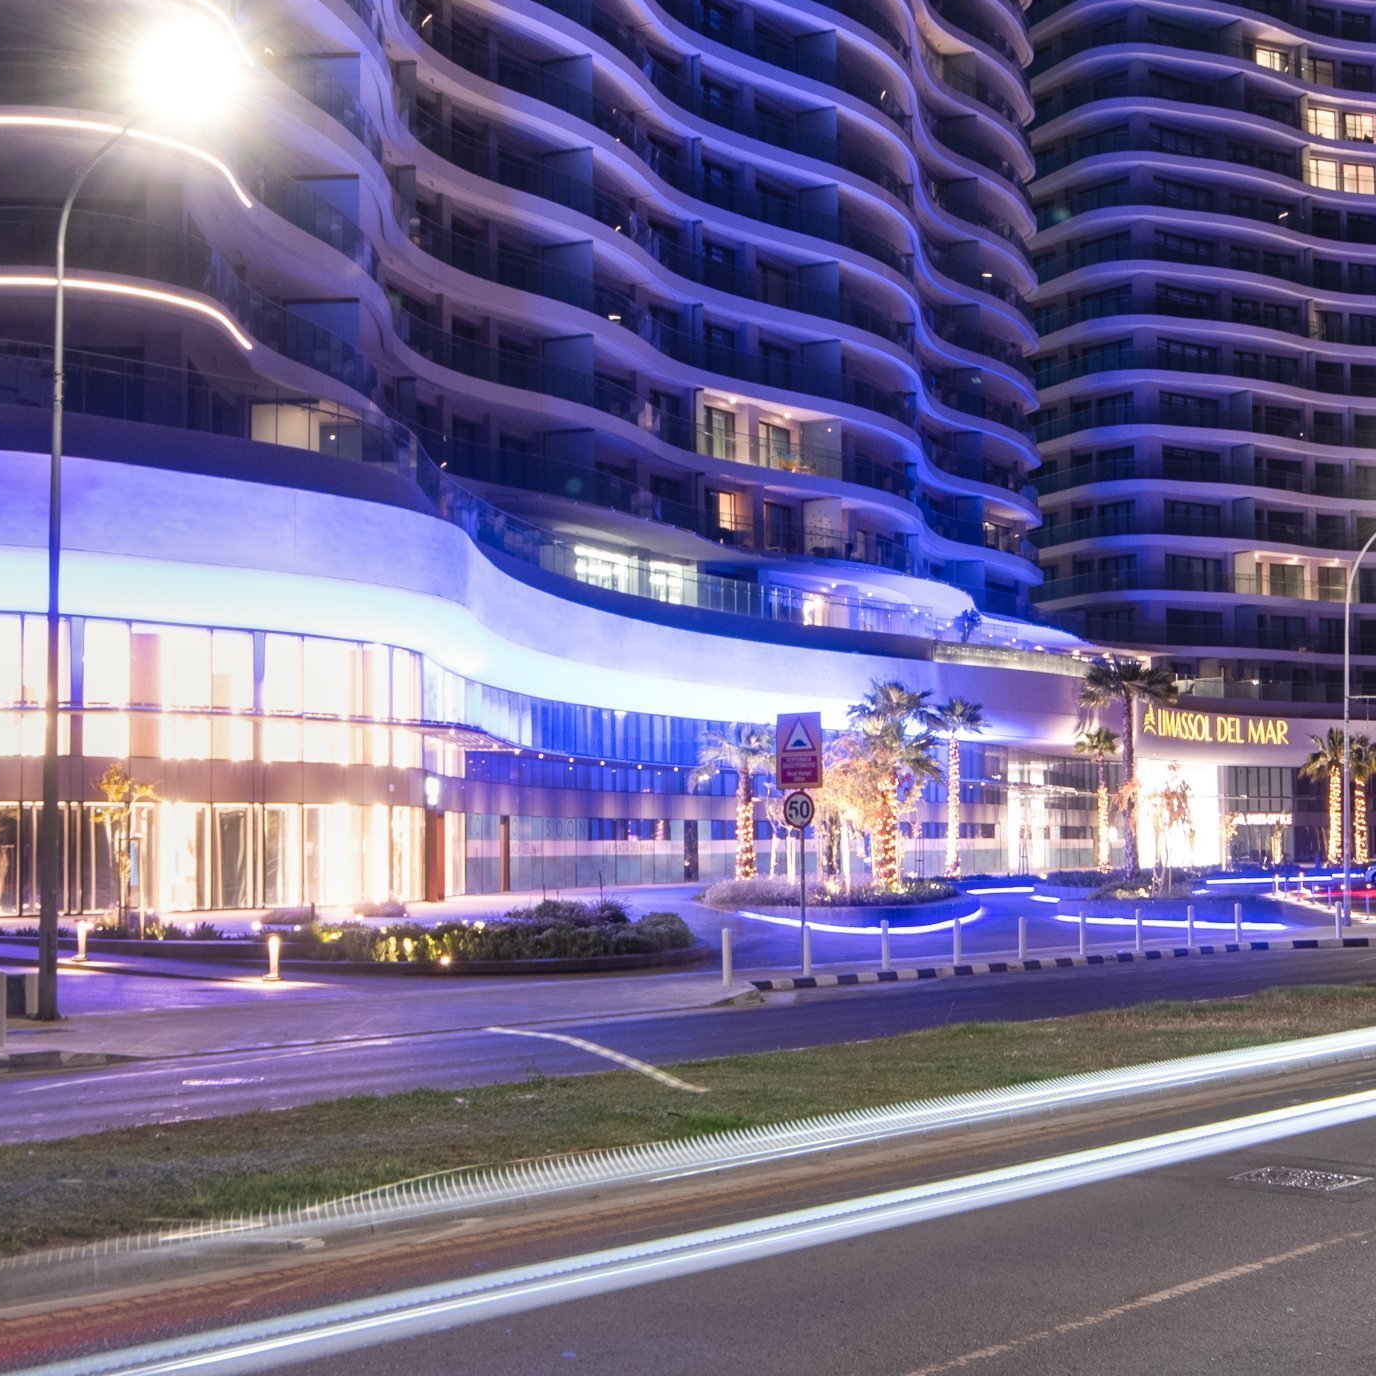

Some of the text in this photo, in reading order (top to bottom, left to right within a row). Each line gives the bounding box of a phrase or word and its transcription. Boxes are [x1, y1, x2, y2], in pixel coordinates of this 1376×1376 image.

[1157, 708, 1289, 745] LIMASSOL DEL MAR
[789, 800, 810, 819] 50
